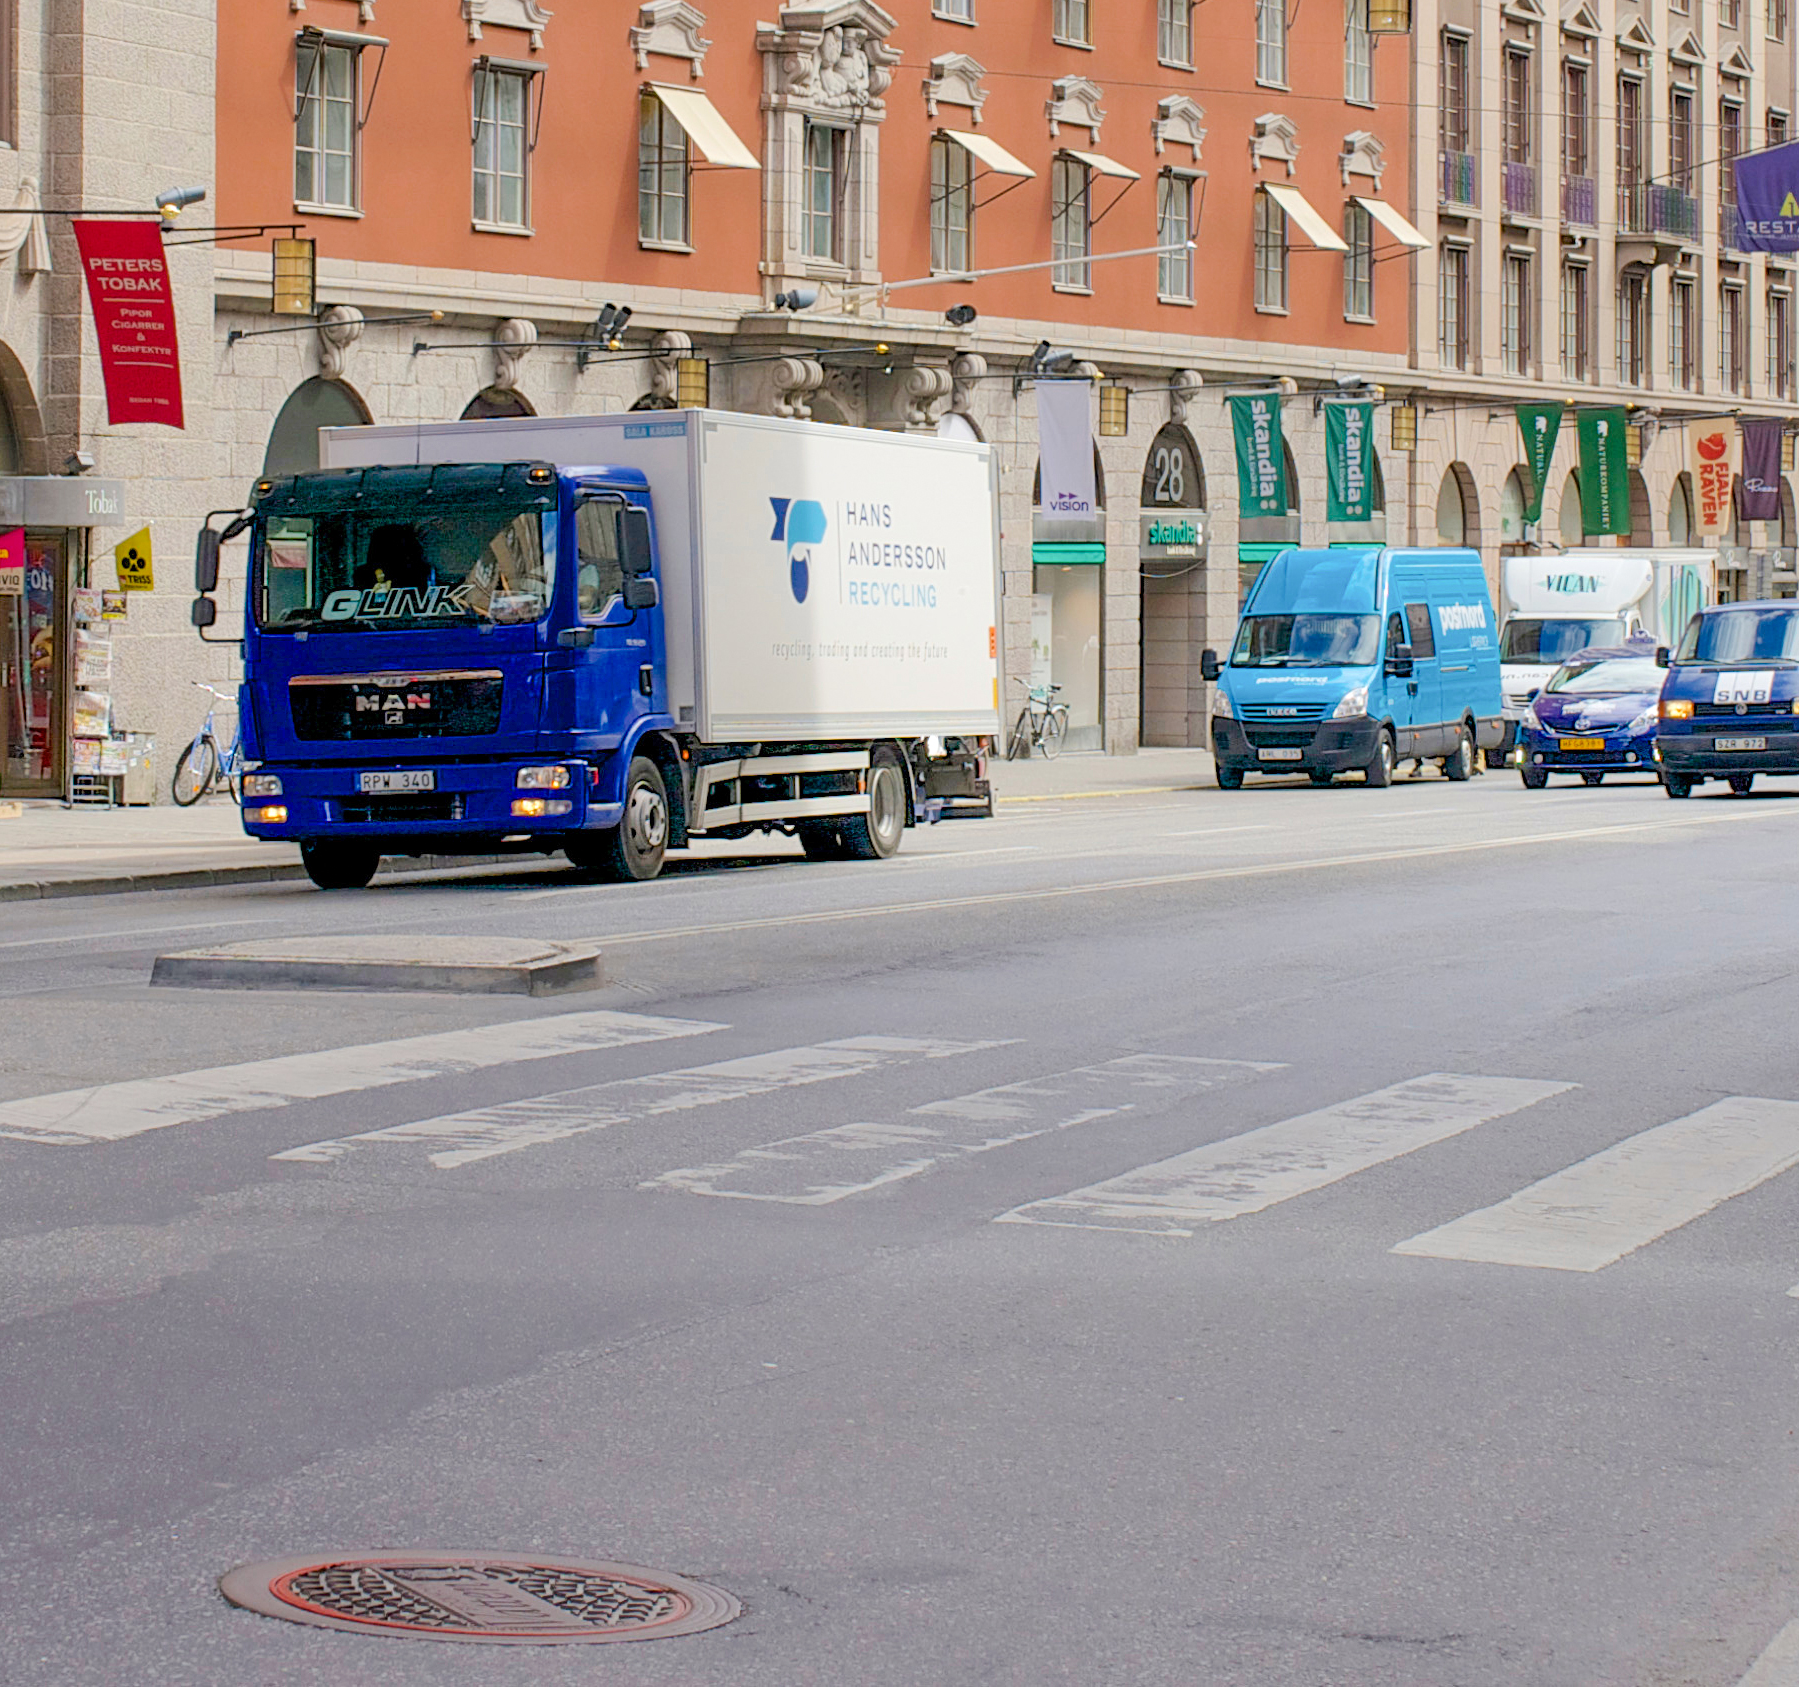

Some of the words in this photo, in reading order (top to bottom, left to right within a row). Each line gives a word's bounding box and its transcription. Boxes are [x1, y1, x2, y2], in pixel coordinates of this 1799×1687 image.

[89, 258, 164, 272] PETERS
[97, 277, 163, 292] TOBAK
[1154, 447, 1185, 503] 28
[1597, 435, 1611, 530] NATURKOMPANIET
[85, 489, 118, 514] Tobak
[1049, 499, 1090, 512] vision
[846, 501, 893, 528] HANS
[847, 541, 947, 571] ANDERSSON
[127, 575, 152, 585] TRISS
[848, 581, 937, 609] RECYCLING
[1438, 600, 1487, 637] postnord
[818, 641, 850, 661] trading
[853, 642, 869, 658] and
[871, 642, 905, 662] creating
[922, 642, 949, 662] future
[1256, 675, 1328, 685] postnord
[355, 693, 432, 712] MAN
[1717, 690, 1767, 702] SNB
[363, 775, 392, 791] RPW
[401, 773, 431, 789] 340
